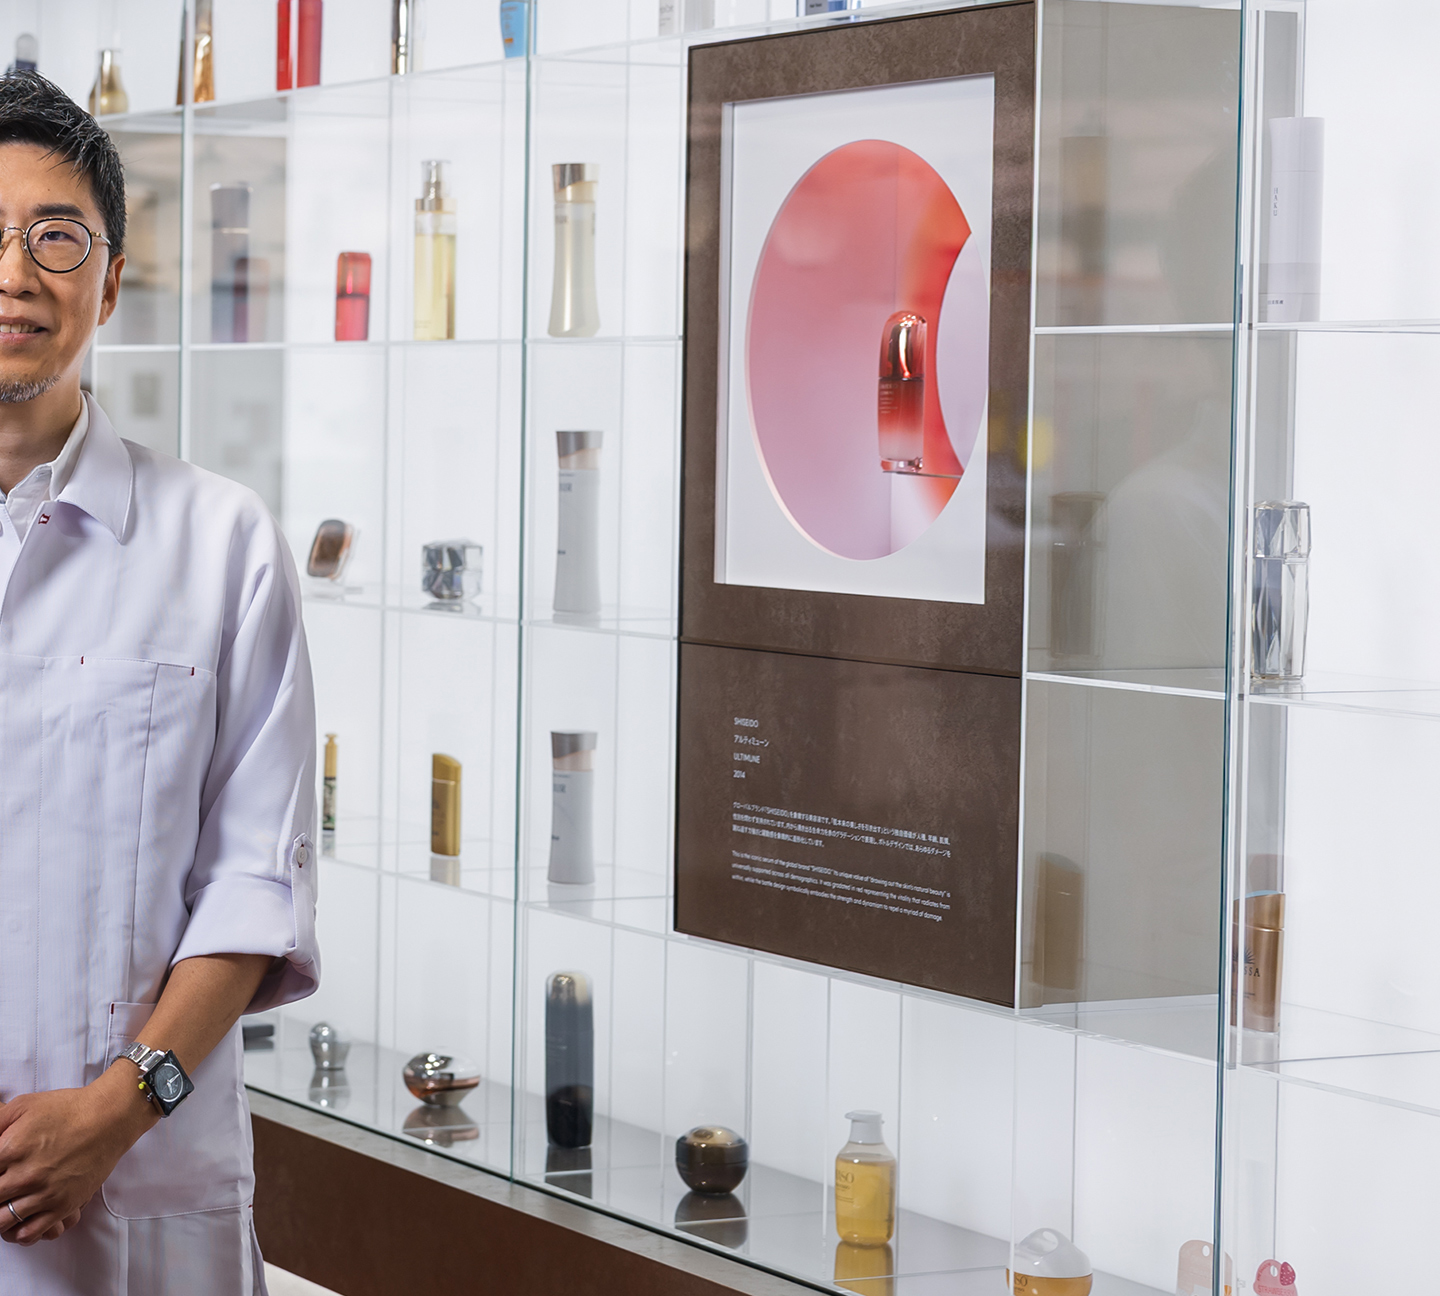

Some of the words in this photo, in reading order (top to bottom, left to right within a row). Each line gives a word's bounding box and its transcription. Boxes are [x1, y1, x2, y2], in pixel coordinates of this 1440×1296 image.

[734, 717, 759, 728] SHISEIDO
[734, 735, 770, 747] アルティミューン
[733, 753, 760, 764] ULTIMUNE
[733, 770, 746, 779] 2014
